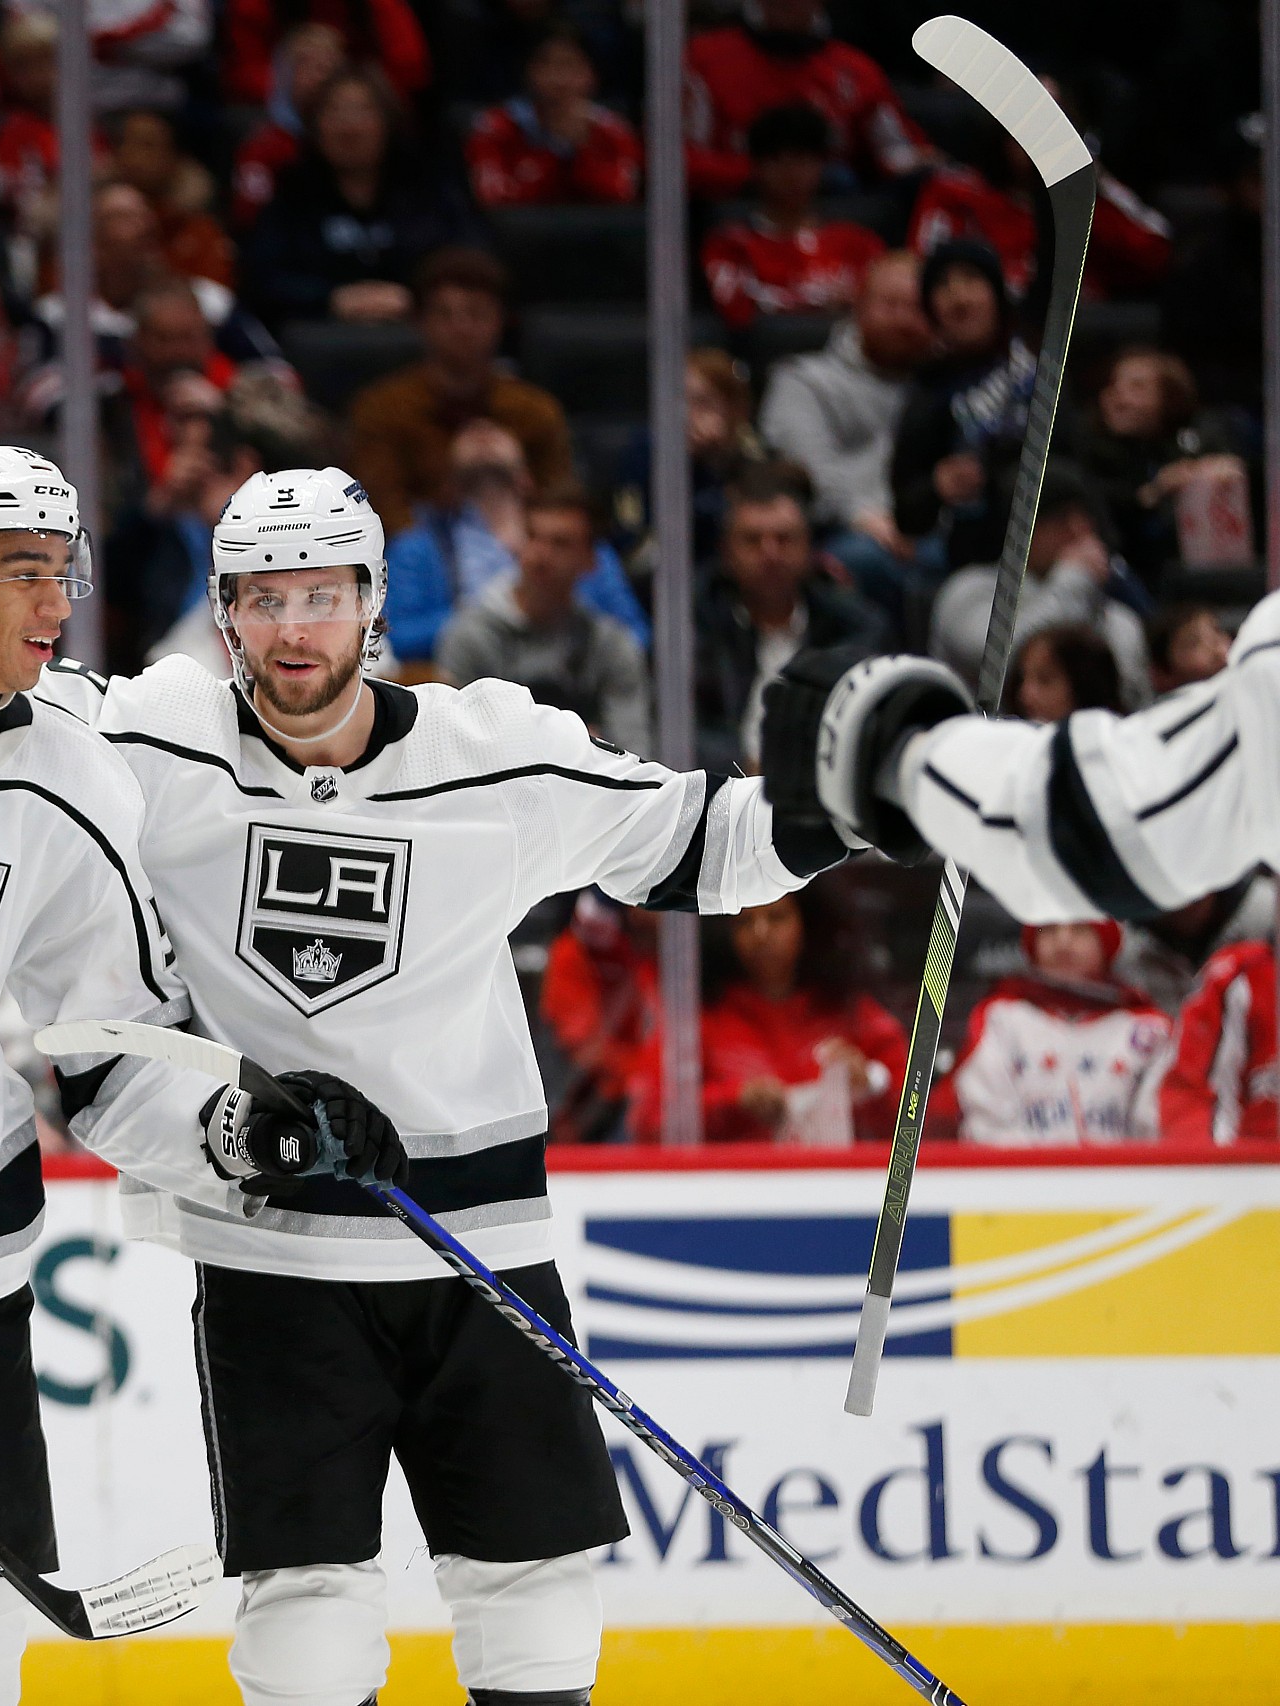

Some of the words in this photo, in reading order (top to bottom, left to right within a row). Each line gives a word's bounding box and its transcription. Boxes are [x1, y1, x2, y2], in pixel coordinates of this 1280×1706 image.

[34, 485, 70, 499] CCM
[257, 522, 312, 533] WARRIOR
[261, 848, 390, 914] LA
[885, 1126, 918, 1226] ALPHA
[914, 1070, 922, 1090] PRO
[433, 1249, 679, 1462] SHERWOOD
